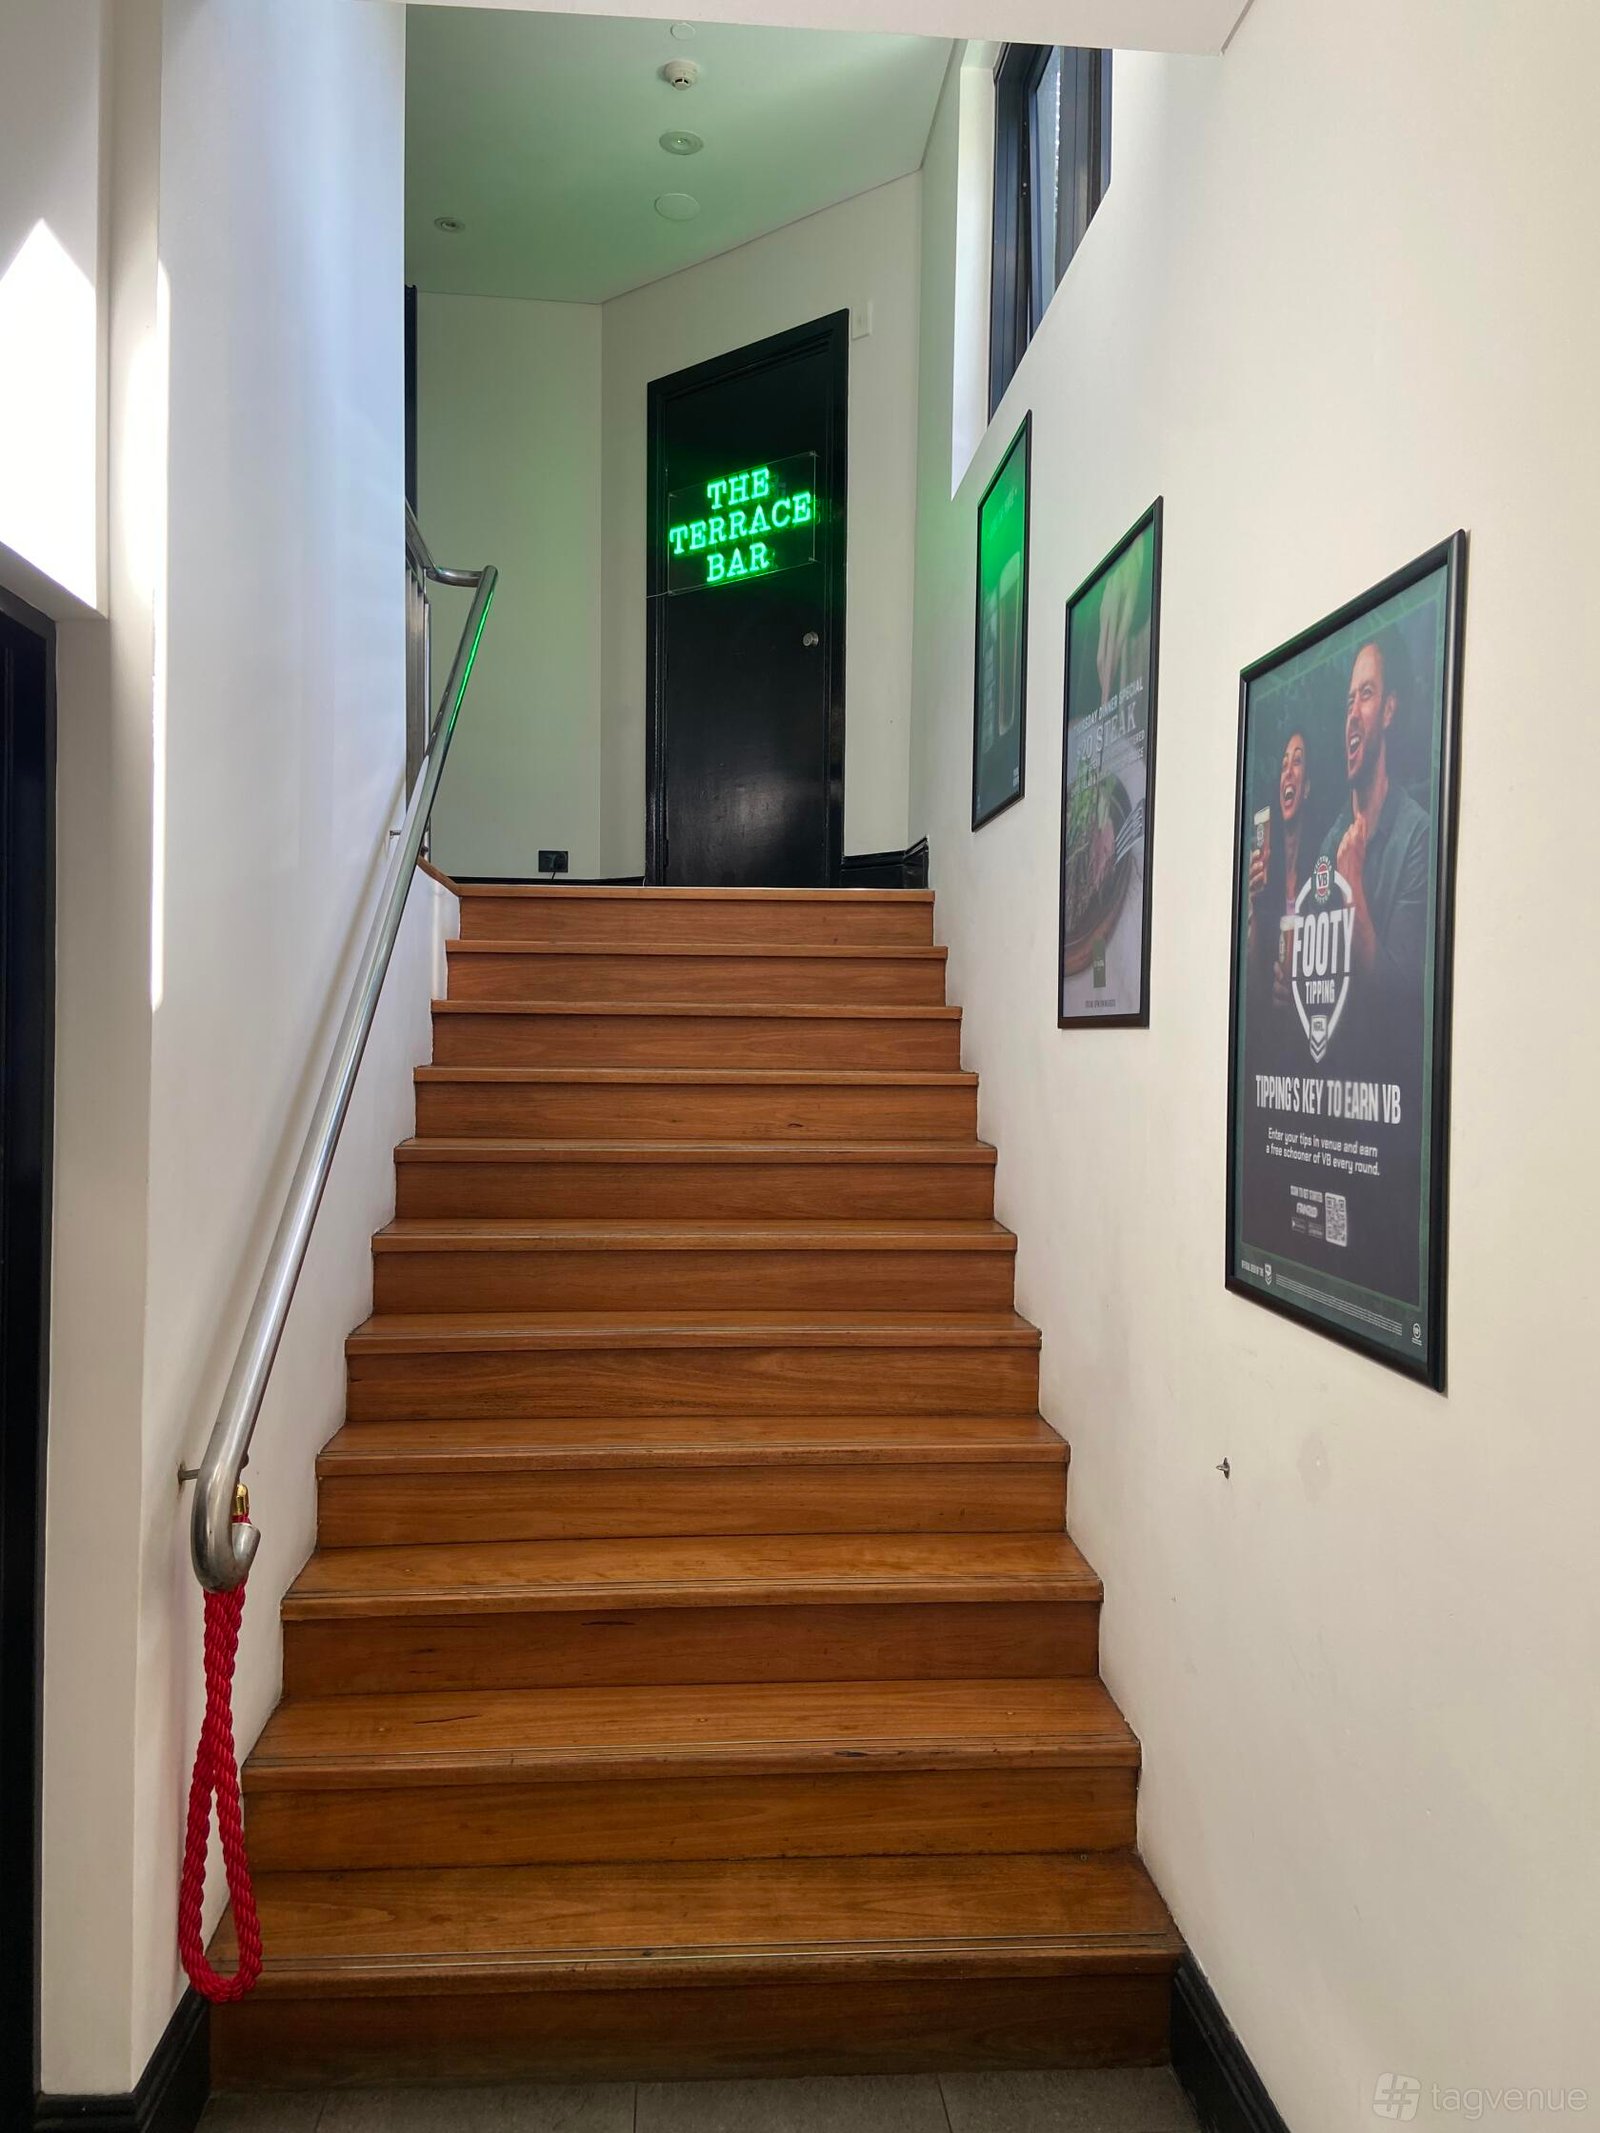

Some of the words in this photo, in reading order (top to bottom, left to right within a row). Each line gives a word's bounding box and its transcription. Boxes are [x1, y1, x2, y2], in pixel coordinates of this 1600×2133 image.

[707, 466, 770, 509] THE
[669, 491, 811, 554] TERRACE
[707, 542, 770, 582] BAR
[1096, 702, 1136, 752] STEAK
[1317, 872, 1328, 887] VB
[1292, 907, 1355, 977] FOOTY
[1305, 979, 1335, 1004] TIPPING
[1255, 1074, 1300, 1112] TIPPING'S
[1302, 1078, 1324, 1115] KEY
[1327, 1080, 1342, 1117] TO
[1344, 1081, 1378, 1122] EARN
[1382, 1084, 1401, 1124] VB
[1268, 1127, 1283, 1141] Enter
[1285, 1132, 1298, 1145] your
[1300, 1132, 1312, 1148] tips
[1313, 1134, 1320, 1147] in
[1321, 1139, 1341, 1151] venue
[1344, 1140, 1358, 1154] and
[1359, 1145, 1378, 1157] earn
[1271, 1143, 1282, 1156] free
[1284, 1146, 1312, 1162] schooner
[1313, 1152, 1320, 1164] of
[1322, 1152, 1331, 1166] VB
[1333, 1158, 1353, 1174] every
[1355, 1162, 1380, 1176] round.
